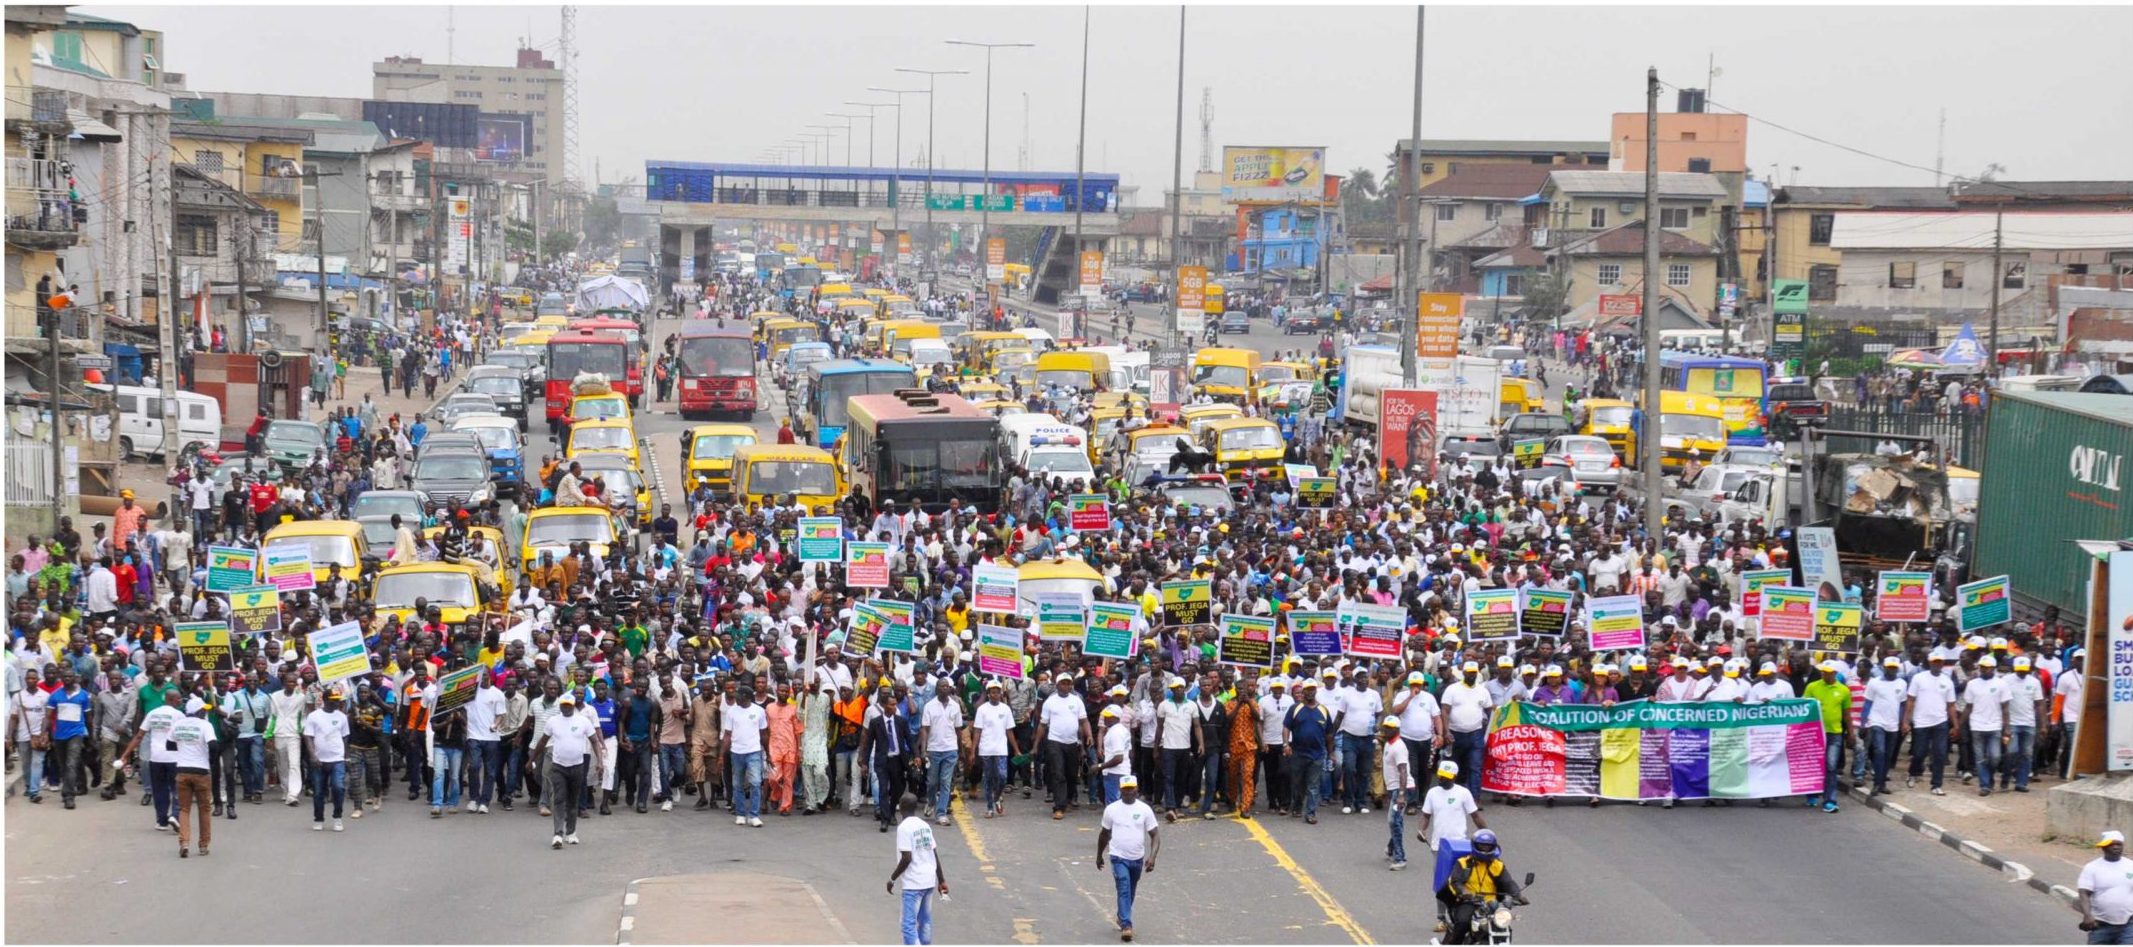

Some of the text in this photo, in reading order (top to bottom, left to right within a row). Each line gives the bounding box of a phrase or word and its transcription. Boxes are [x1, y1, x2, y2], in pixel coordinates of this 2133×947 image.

[1233, 171, 1269, 181] FIZZZ
[1430, 302, 1448, 312] Stay
[1421, 315, 1459, 323] connected
[1779, 314, 1801, 323] ATM
[1440, 344, 1452, 352] out
[1152, 373, 1169, 394] JK
[1386, 404, 1415, 416] LAGOS
[1386, 422, 1409, 431] WANT
[1165, 603, 1187, 611] PROF.
[234, 608, 276, 618] PROF. JEGA
[1176, 609, 1198, 617] MUST
[244, 616, 267, 625] MUST
[1181, 616, 1194, 624] GO
[1836, 626, 1857, 635] JEGA
[1820, 635, 1845, 643] MUST
[182, 646, 229, 655] PROF. JEGA
[201, 662, 215, 670] GO
[1528, 703, 1811, 724] COALITION OF CONCERNED NIGERIANS
[1494, 726, 1554, 743] 7 REASONS
[1507, 741, 1538, 753] PROF.
